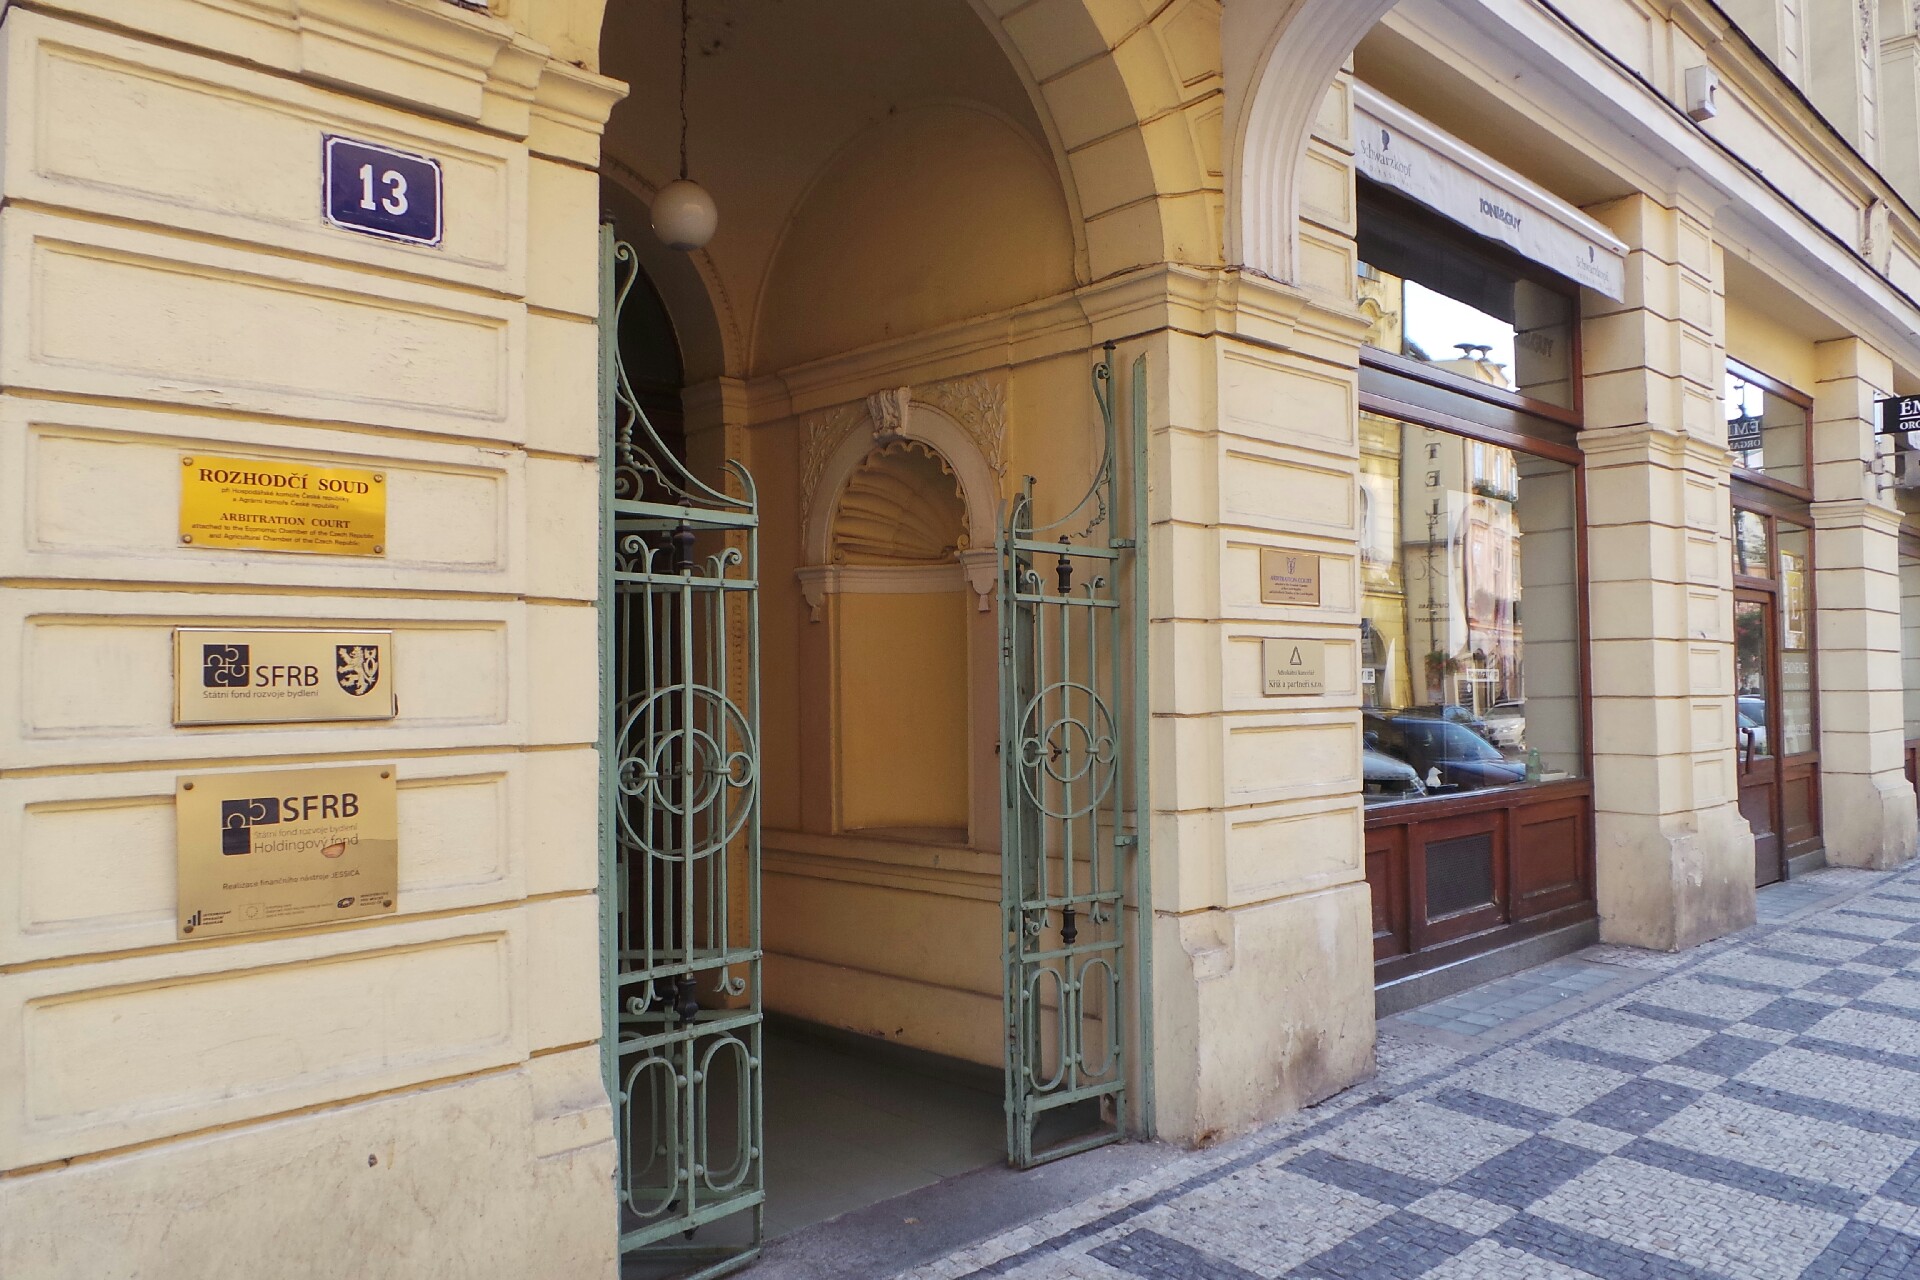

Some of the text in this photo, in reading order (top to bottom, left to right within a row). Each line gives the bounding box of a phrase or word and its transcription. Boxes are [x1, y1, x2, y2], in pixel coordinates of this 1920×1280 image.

[1361, 139, 1412, 177] Schwarzkopf
[359, 163, 409, 217] 13
[1479, 197, 1521, 232] TONI&GUY
[198, 468, 369, 494] ROZHODČÍ SOUD
[220, 512, 351, 529] ARBITRATION COURT
[224, 533, 261, 541] Agricultural
[255, 665, 319, 688] SFRB
[231, 690, 251, 699] fond
[253, 690, 285, 700] rozvoje
[287, 689, 319, 700] bydlení
[282, 793, 360, 822] SFRB
[279, 828, 298, 837] fond
[299, 826, 328, 836] rozvoje
[254, 833, 359, 854] Holdingový fond
[222, 869, 361, 890] Realizace finančního nástroje JESSICA
